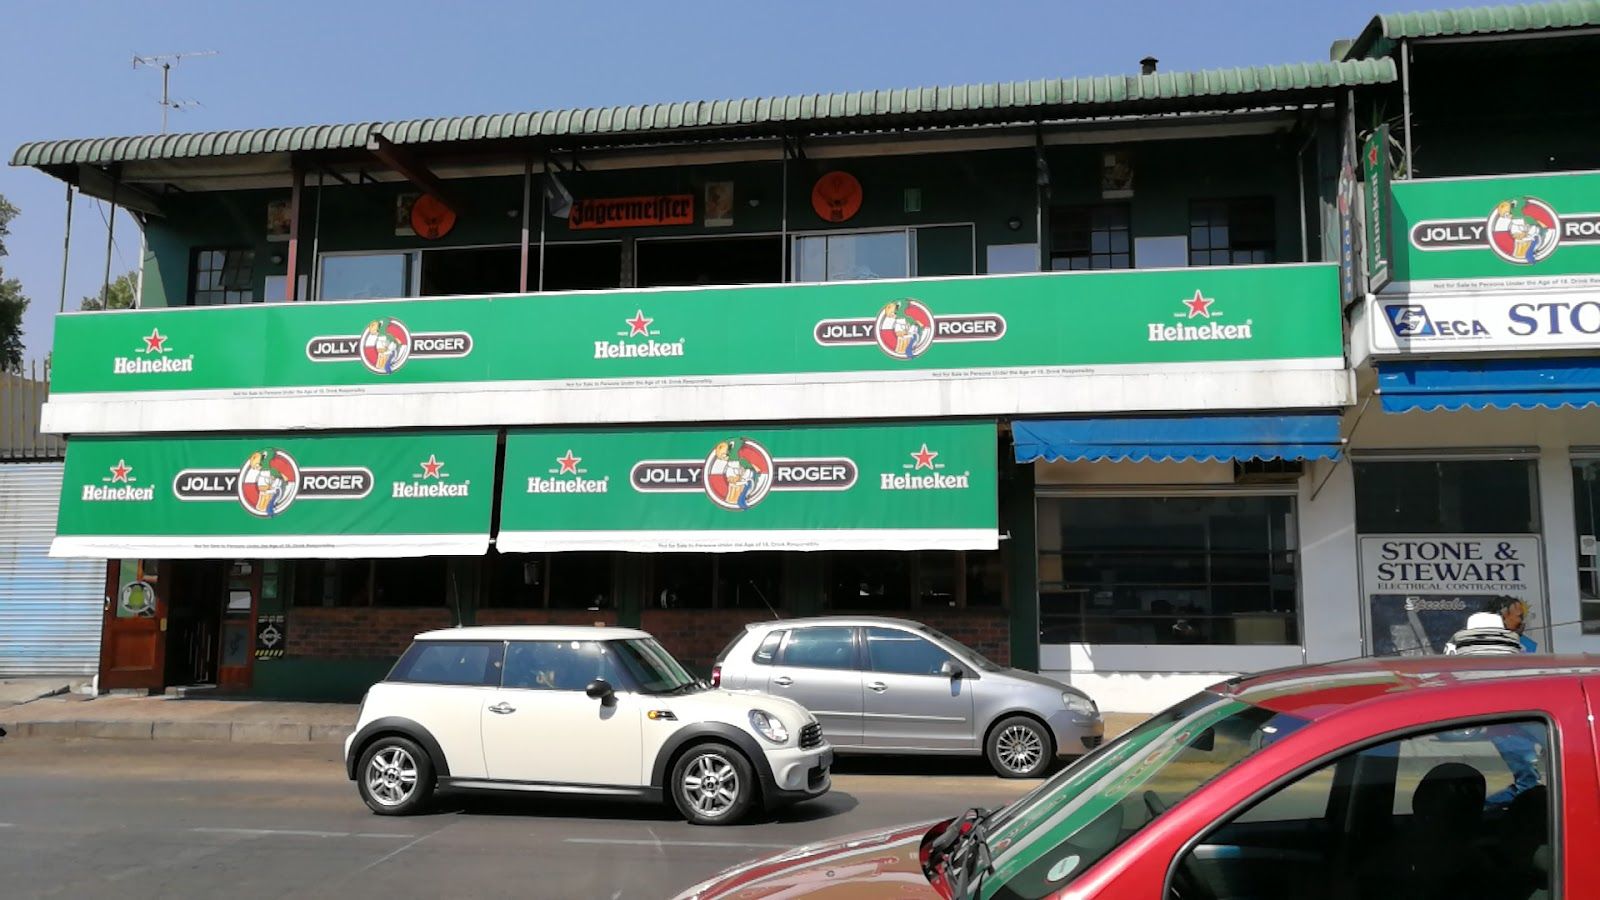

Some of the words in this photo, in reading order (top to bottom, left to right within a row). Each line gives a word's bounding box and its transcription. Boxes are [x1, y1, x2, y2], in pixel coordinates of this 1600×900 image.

[1371, 172, 1382, 269] Heineken
[1421, 226, 1484, 242] JOLLY
[822, 324, 873, 338] JOLLY
[938, 320, 996, 334] ROGER
[1147, 320, 1253, 342] Heineken
[313, 341, 358, 355] JOLLY
[413, 337, 465, 351] ROGER
[593, 338, 685, 359] Heineken
[113, 355, 194, 374] Heineken
[181, 476, 236, 491] JOLLY
[303, 474, 364, 490] ROGER
[639, 468, 701, 483] JOLLY
[777, 466, 846, 481] ROGER
[880, 471, 969, 490] Heineken
[81, 484, 154, 501] Heineken
[392, 480, 470, 498] Heineken
[527, 476, 608, 493] Heineken
[1381, 541, 1483, 561] STONE
[1494, 541, 1519, 561] &
[1377, 562, 1525, 581] STEWART
[1378, 582, 1441, 591] ELECTRICAL
[1446, 582, 1527, 591] CONTRACTORS
